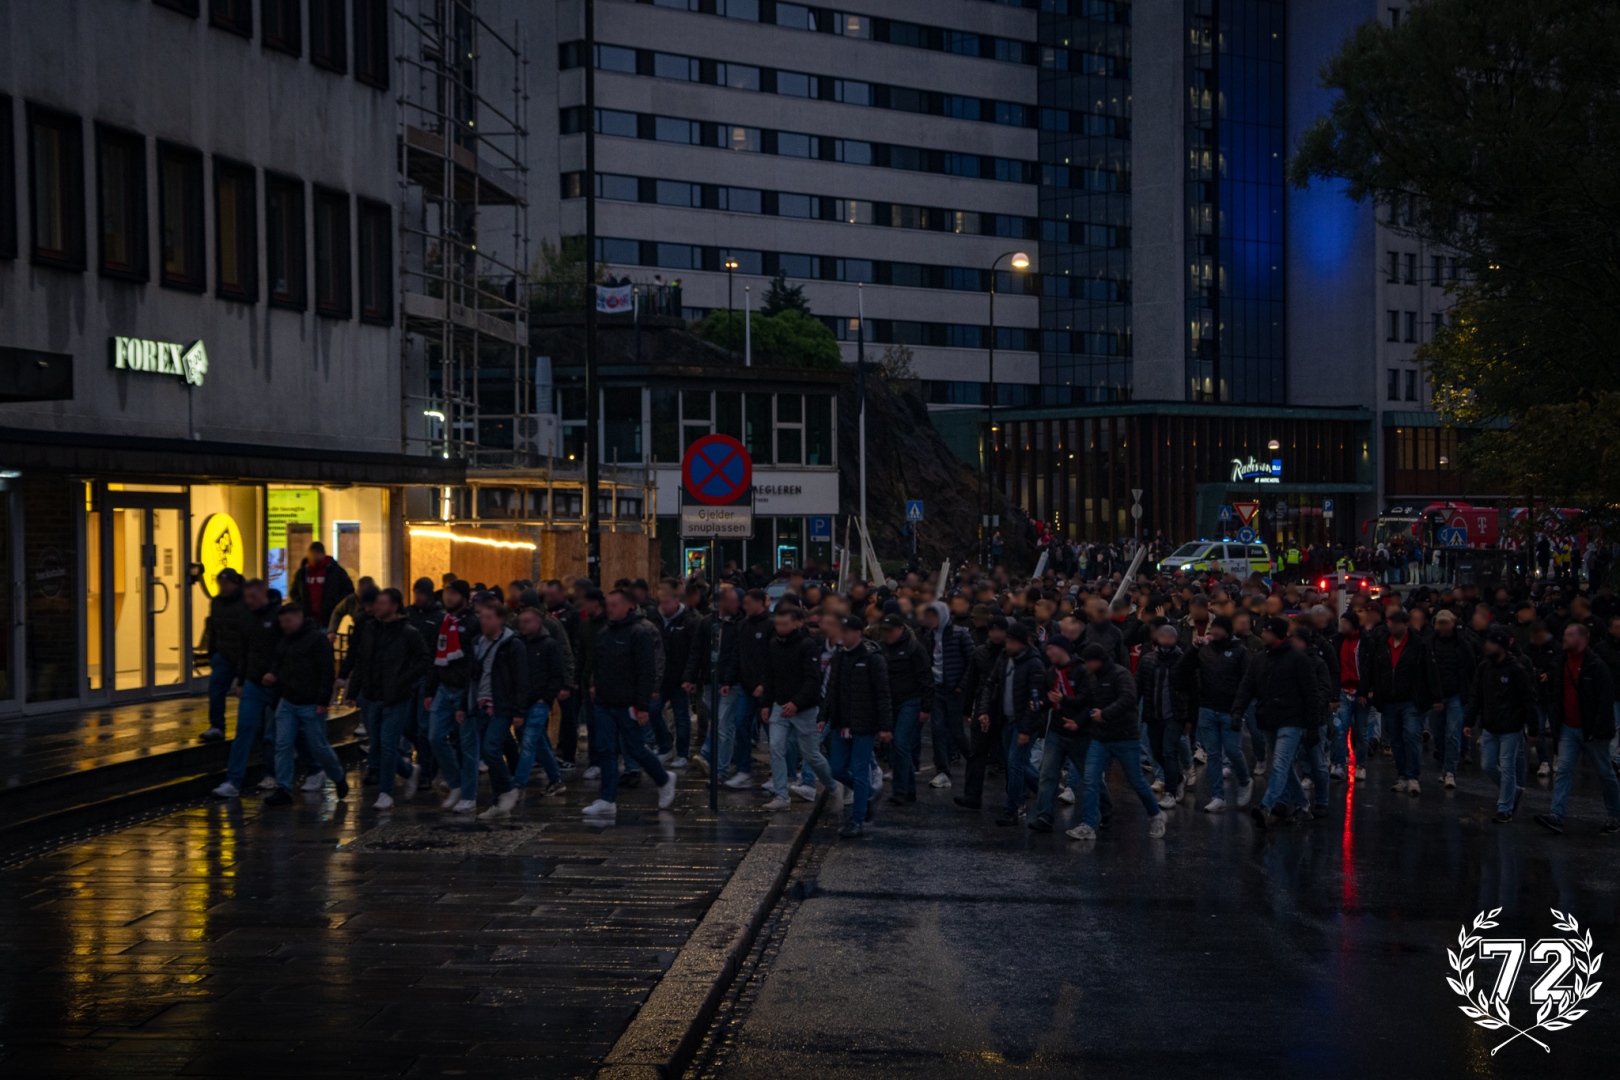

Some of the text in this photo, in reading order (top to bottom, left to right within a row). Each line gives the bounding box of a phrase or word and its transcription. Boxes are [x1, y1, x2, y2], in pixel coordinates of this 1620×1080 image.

[115, 336, 185, 375] FOREX
[1230, 456, 1272, 483] Radison
[699, 509, 735, 521] Gjelder
[688, 523, 746, 534] snuplassen
